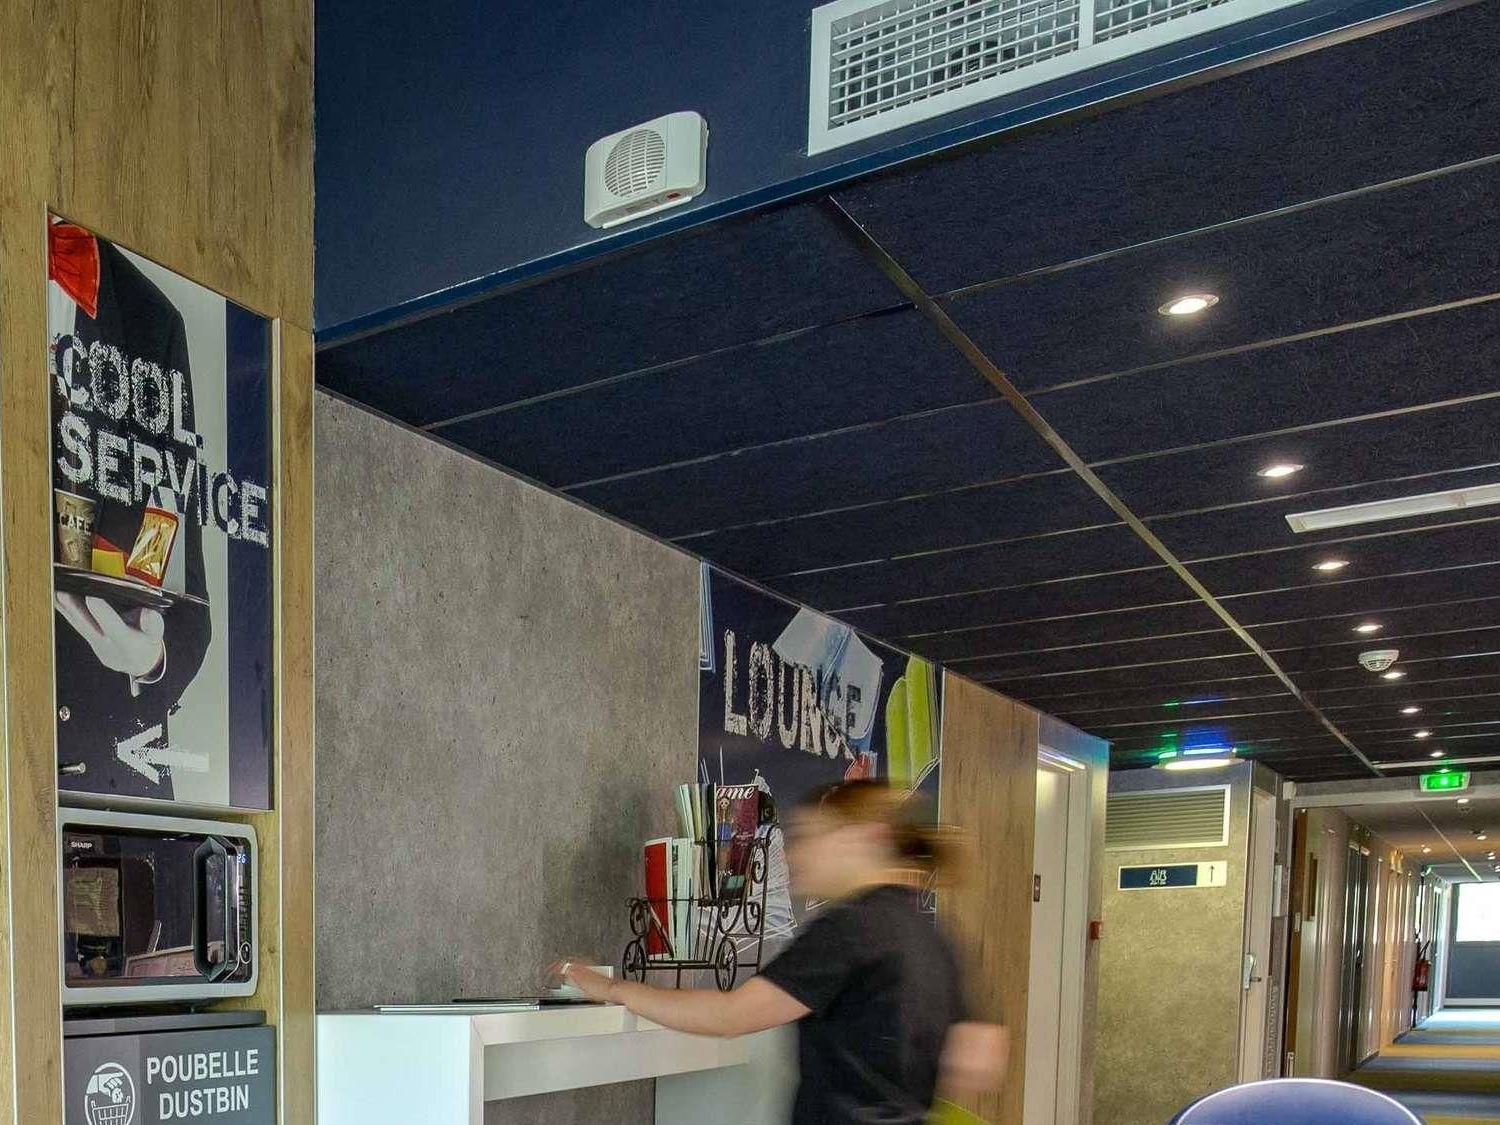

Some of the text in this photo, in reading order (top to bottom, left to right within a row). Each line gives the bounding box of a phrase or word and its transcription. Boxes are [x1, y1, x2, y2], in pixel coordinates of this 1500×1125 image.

[53, 332, 204, 450] COOL
[56, 409, 270, 549] SERVICE
[70, 841, 93, 850] SHARP
[146, 1048, 259, 1085] POUBELLE
[159, 1083, 250, 1121] DUSTBIN
